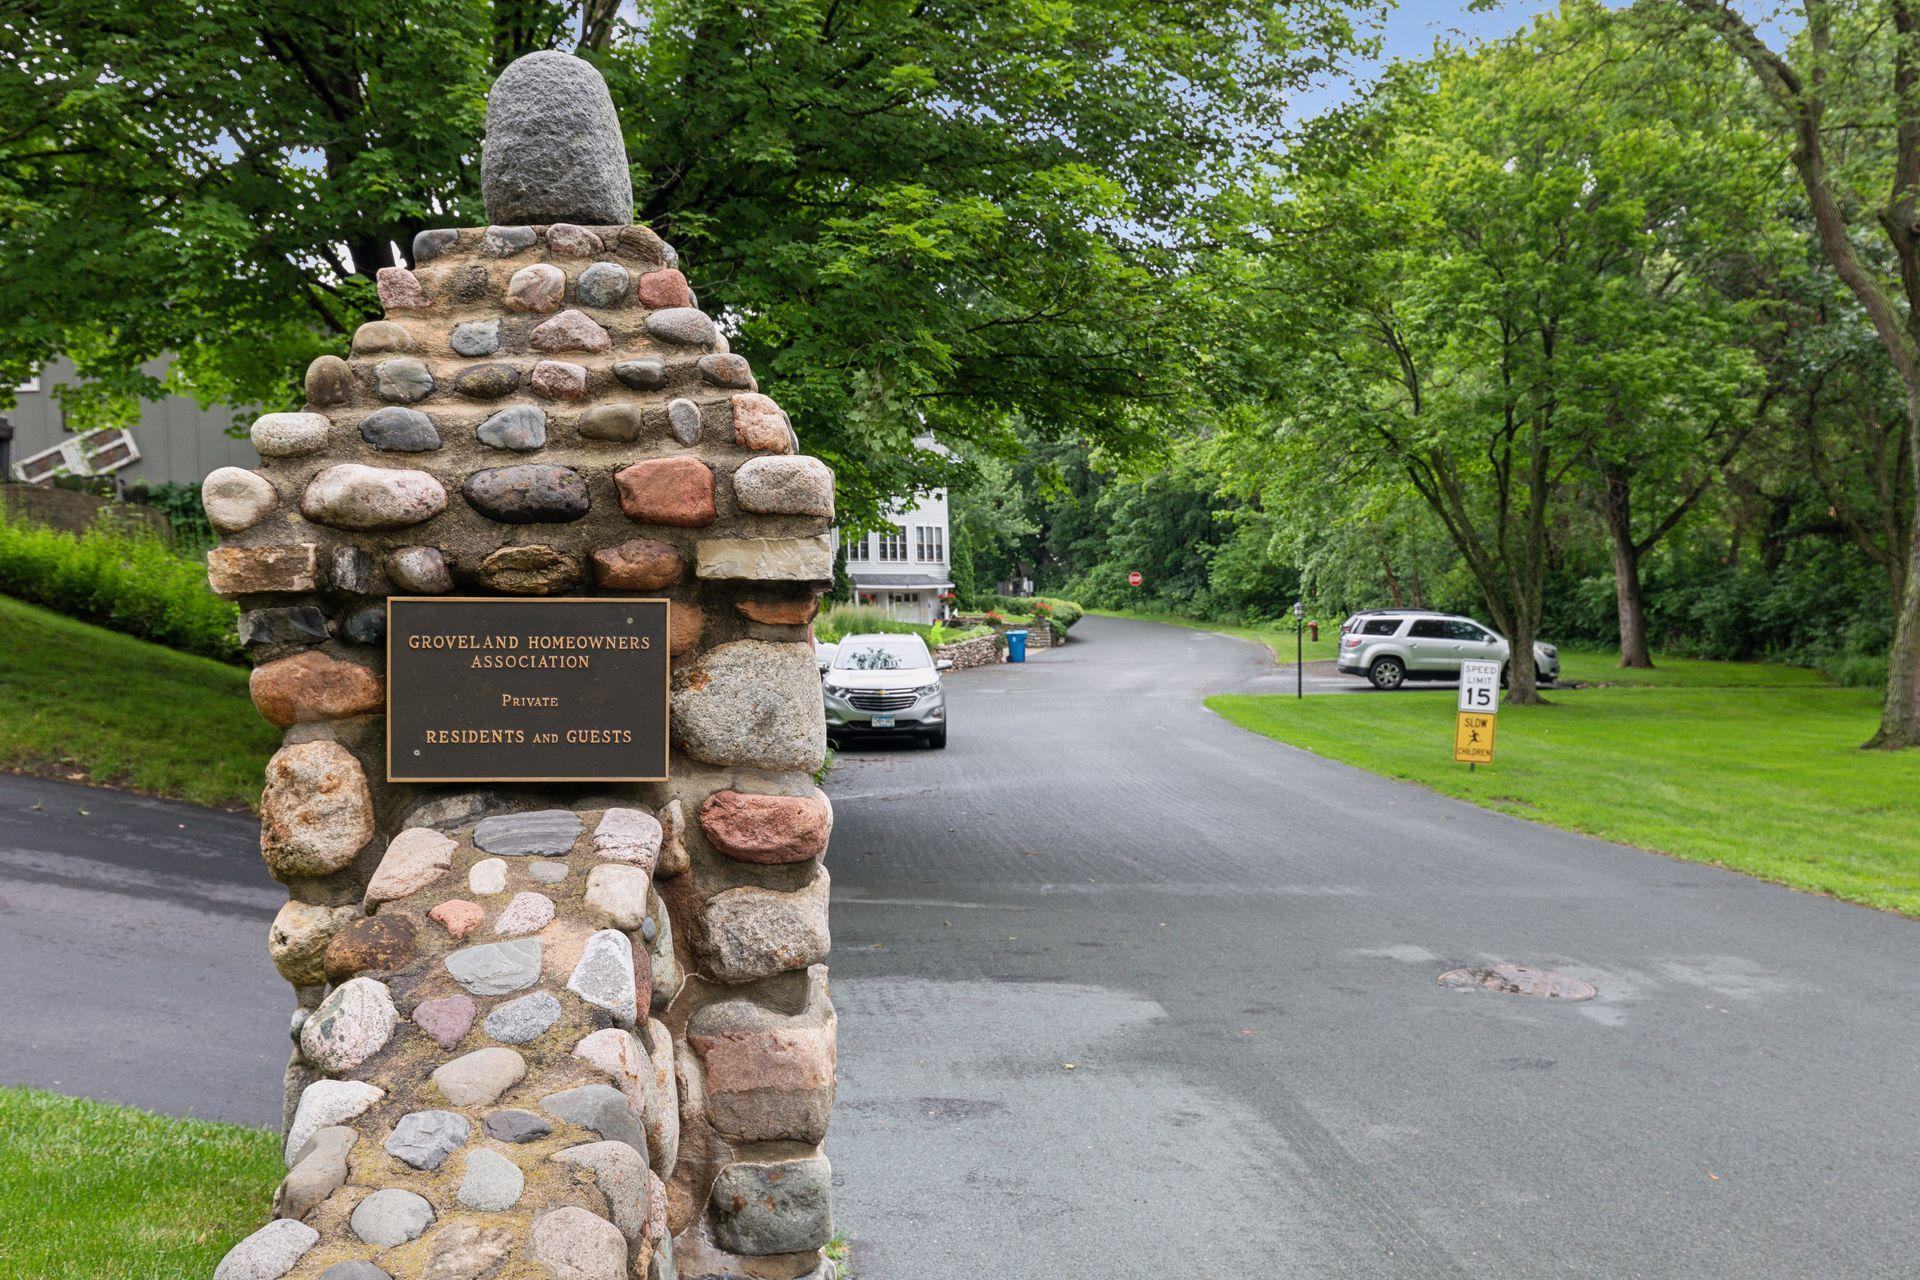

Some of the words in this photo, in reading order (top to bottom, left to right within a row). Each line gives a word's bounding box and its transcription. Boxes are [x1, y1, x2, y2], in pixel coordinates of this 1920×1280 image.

[408, 635, 519, 650] GROVELAND
[528, 635, 650, 650] HOMEOWNERS
[470, 655, 590, 669] ASSOCIATION
[1465, 665, 1497, 674] SPEED
[1467, 687, 1490, 706] 15
[1464, 718, 1487, 728] SLOW
[426, 730, 525, 744] RESIDENTS
[532, 733, 559, 743] AND
[566, 730, 632, 743] GUESTS
[1457, 748, 1490, 756] CHILDREN
